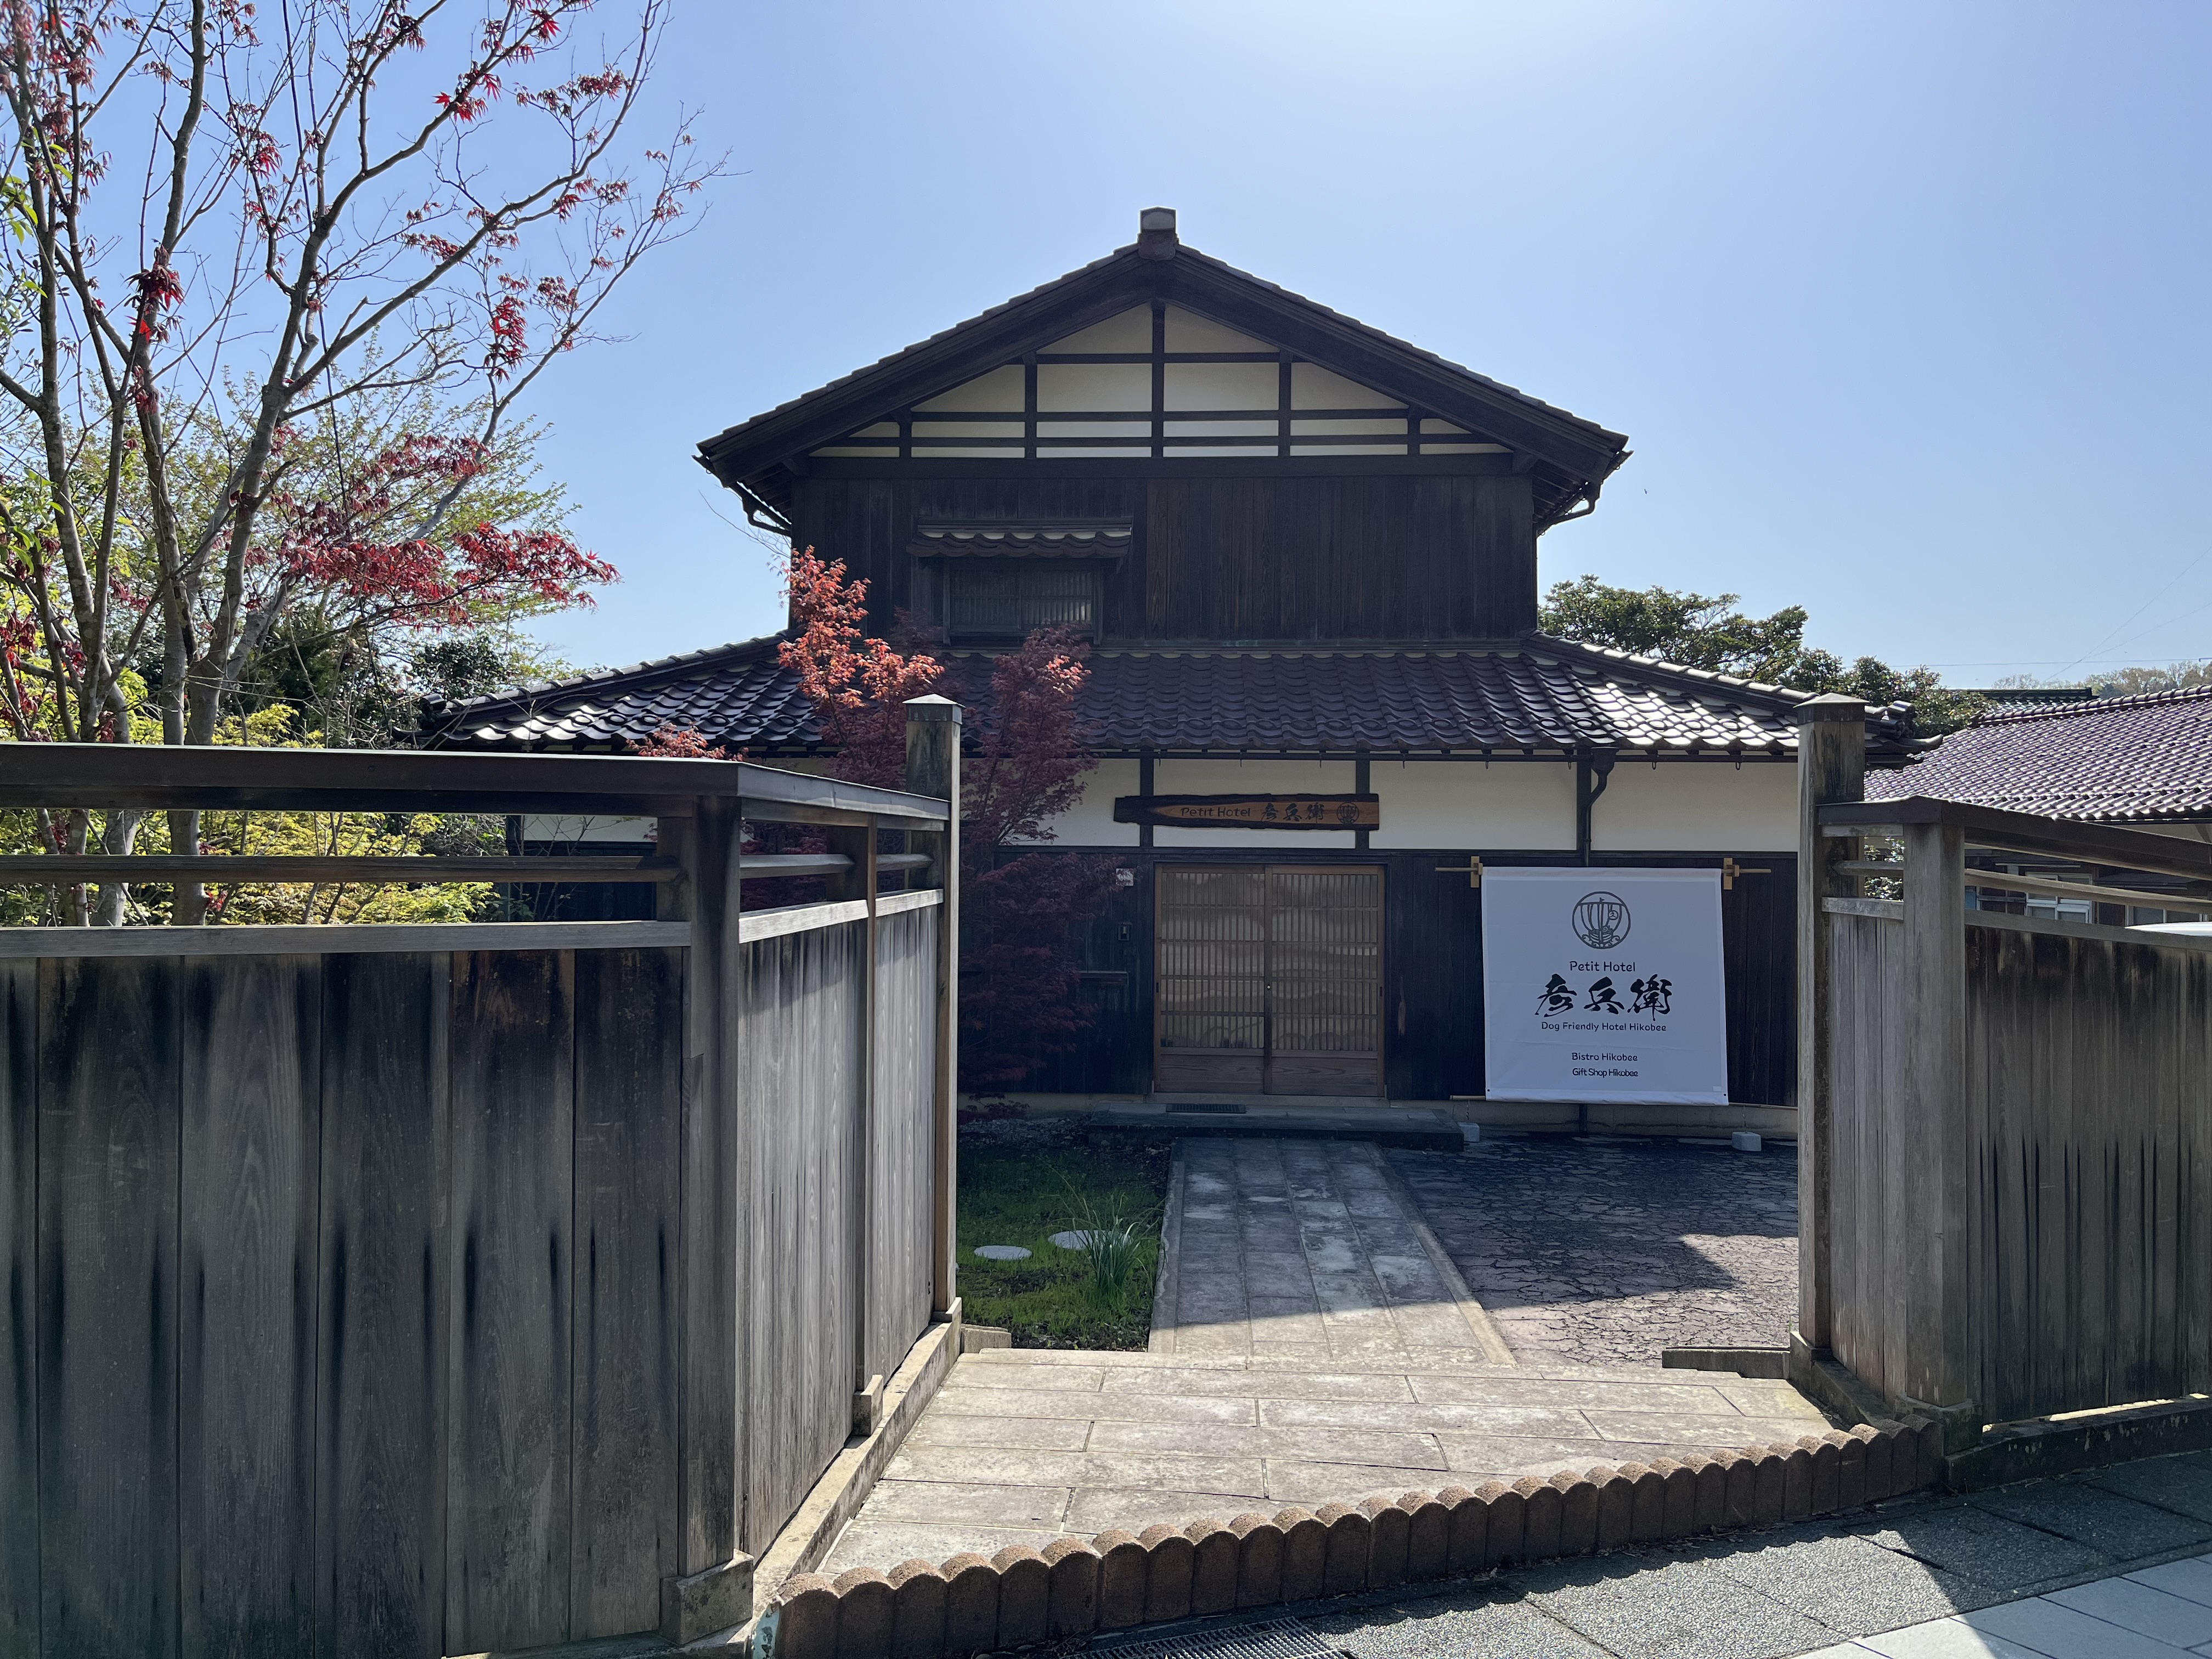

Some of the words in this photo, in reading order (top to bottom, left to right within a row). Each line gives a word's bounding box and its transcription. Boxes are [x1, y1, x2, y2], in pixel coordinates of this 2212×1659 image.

[1181, 807, 1214, 817] Petit
[1217, 807, 1250, 817] Hotel
[1569, 961, 1600, 972] Petit
[1604, 961, 1635, 972] Hotel
[1541, 1022, 1560, 1031] Dog
[1562, 1022, 1599, 1032] Friendly
[1602, 1023, 1627, 1031] Hotel
[1629, 1023, 1667, 1031] Hikobee
[1571, 1052, 1599, 1060] Bistro
[1601, 1053, 1638, 1062] Hikobee
[1572, 1068, 1587, 1076] Gift
[1588, 1068, 1607, 1079] Shop
[1608, 1069, 1639, 1077] Hikobee
